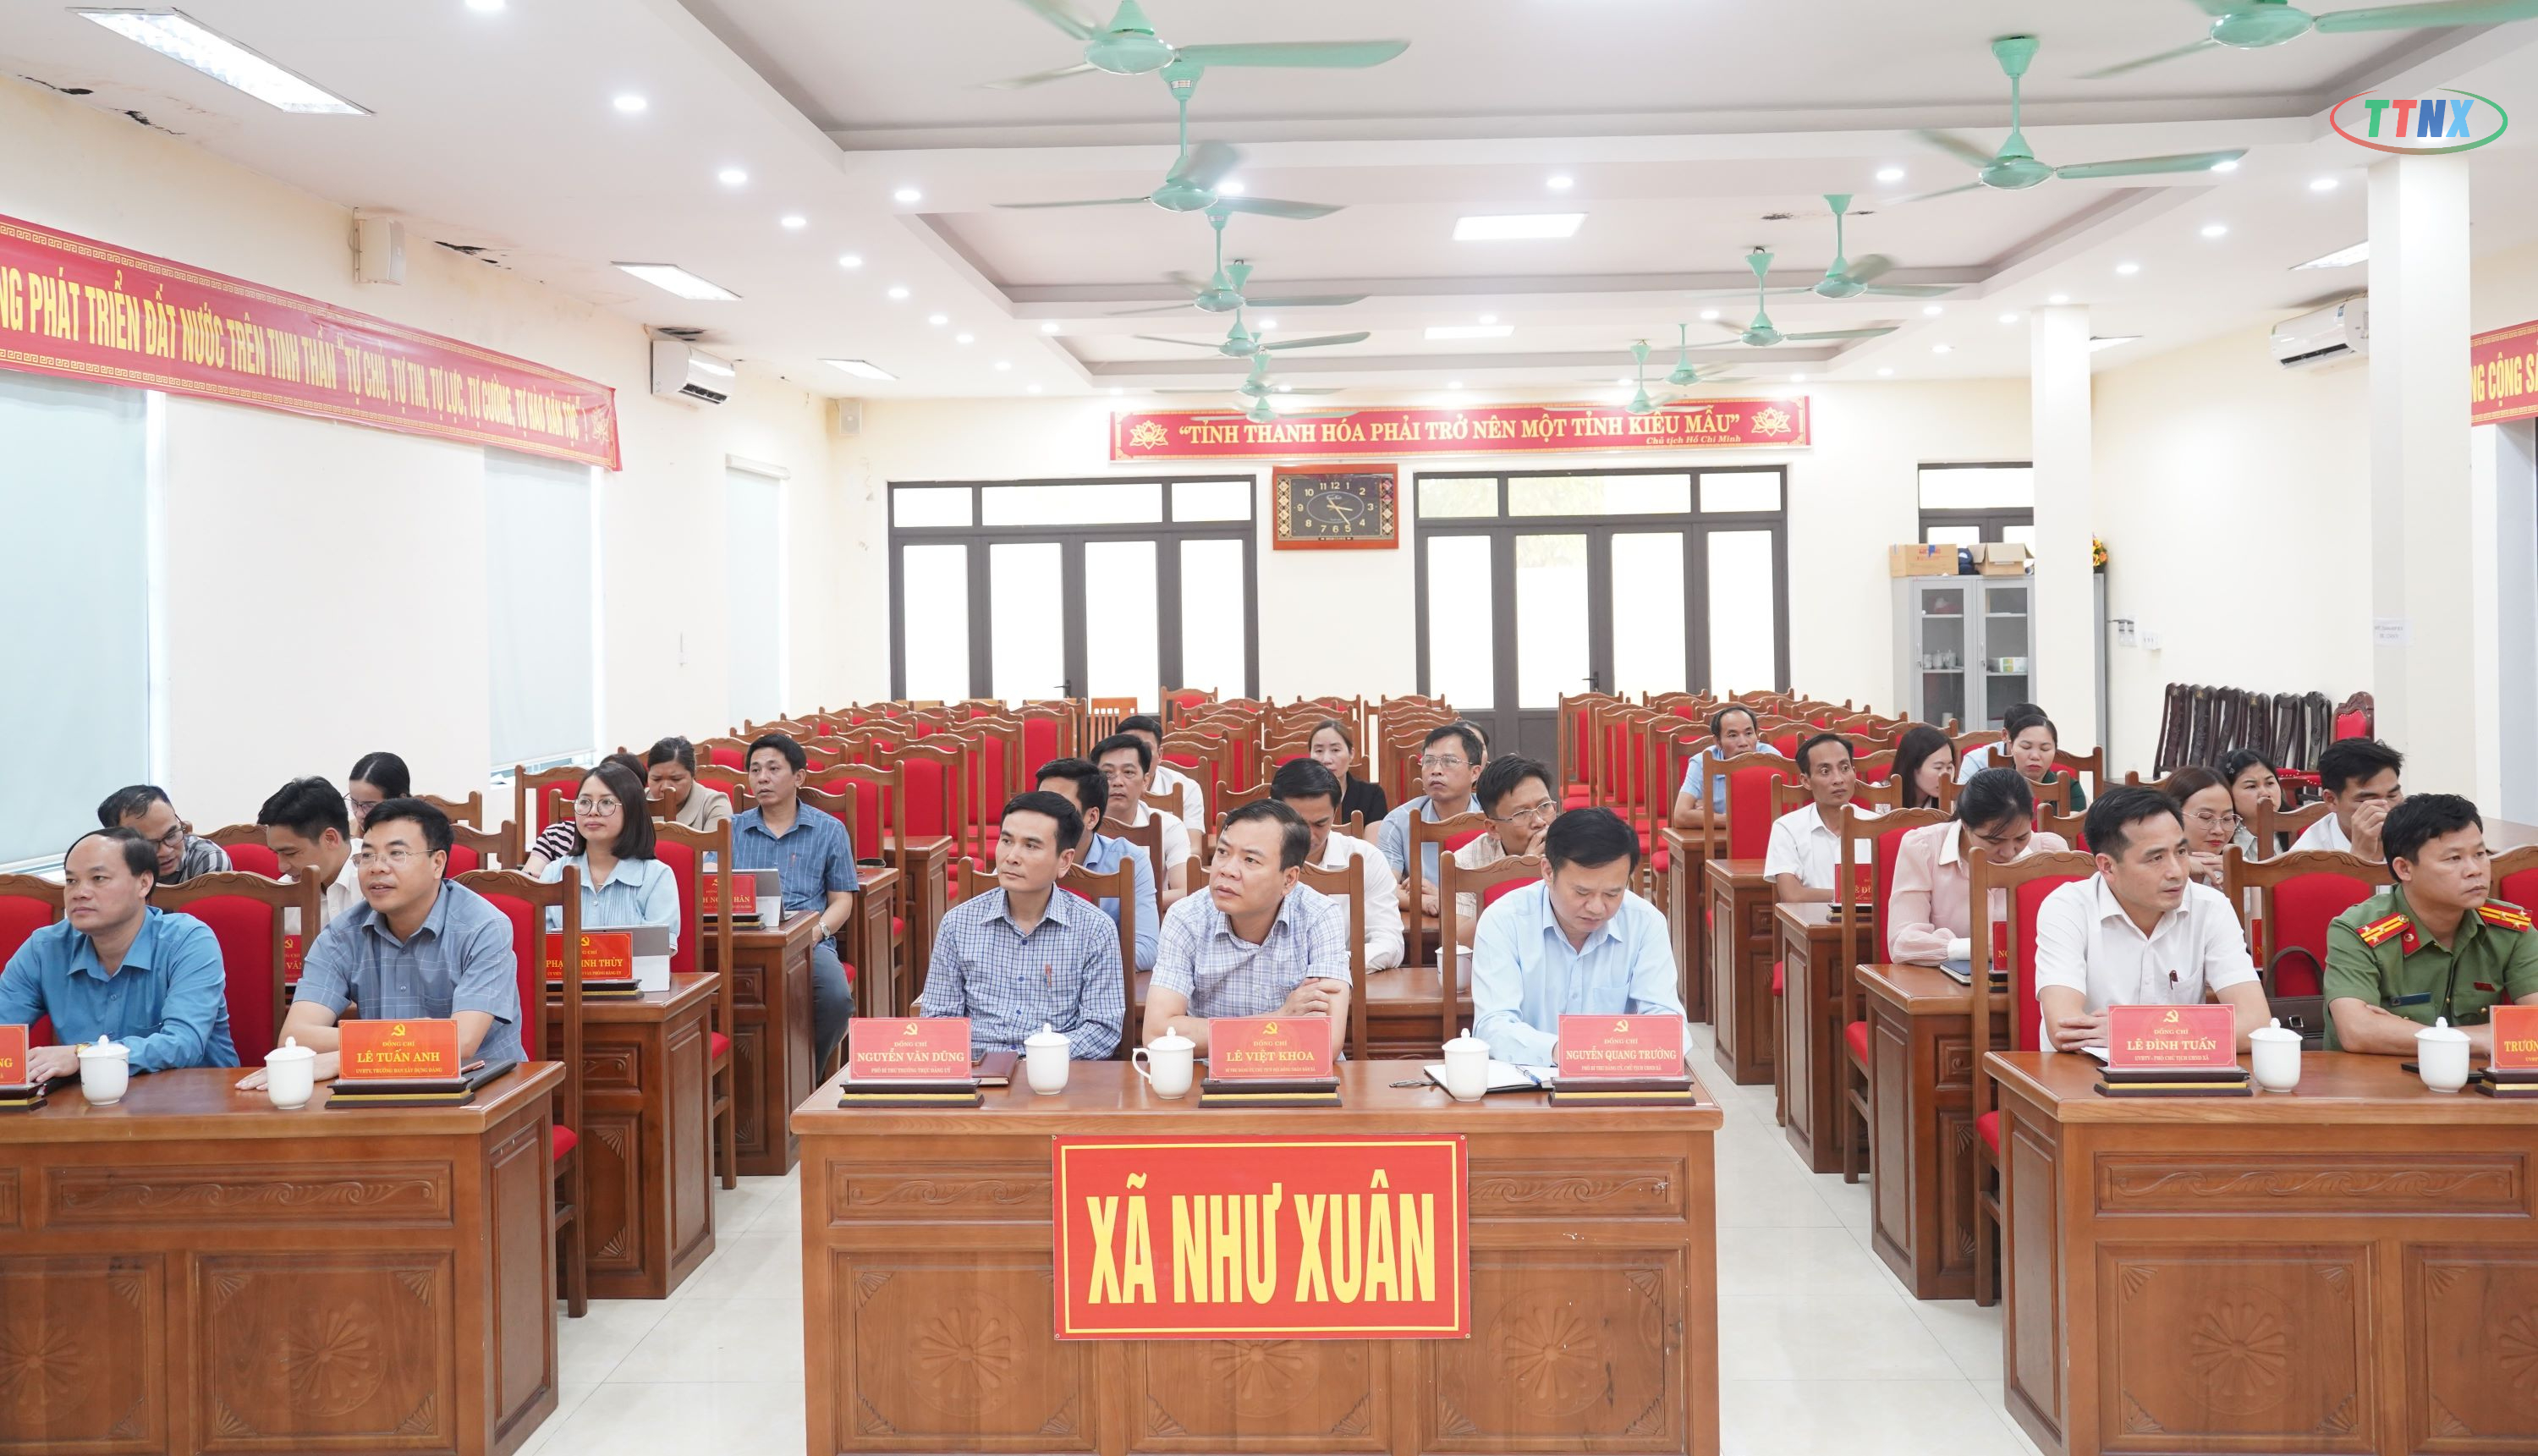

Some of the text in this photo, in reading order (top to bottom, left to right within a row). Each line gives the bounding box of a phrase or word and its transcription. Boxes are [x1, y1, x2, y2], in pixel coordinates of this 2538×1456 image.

[28, 266, 80, 342] PHÁT
[85, 270, 140, 352] TRIỂN
[144, 284, 176, 359] ĐẤT
[181, 302, 225, 368] NƯỚC
[227, 312, 266, 376] TRÊN
[266, 327, 300, 383] TINH
[301, 327, 337, 389] THẦN
[392, 356, 406, 414] TỰ
[430, 365, 444, 420] TỰ
[2488, 352, 2523, 407] CỘNG
[1179, 420, 1239, 443] “TỈNH
[1244, 424, 1316, 443] THANH
[1321, 418, 1366, 442] HÓA
[1370, 415, 1421, 441] PHẢI
[1425, 414, 1469, 440] TRỞ
[1472, 415, 1517, 439] NÊN
[1521, 413, 1568, 443] MỘT
[1571, 410, 1623, 437] TỈNH
[1667, 436, 1684, 446] tịch
[1718, 434, 1741, 442] Minh
[1320, 482, 1327, 491] 11
[1331, 481, 1340, 490] 12
[1305, 488, 1315, 497] 10
[1359, 487, 1366, 496] 2
[1296, 503, 1305, 513] 9
[1367, 503, 1375, 512] 3
[1305, 519, 1313, 528] 8
[1359, 519, 1366, 527] 4
[1320, 525, 1327, 533] 7
[1332, 525, 1340, 534] 6
[1344, 524, 1352, 533] 5
[546, 959, 563, 970] PHẠ
[2127, 1036, 2217, 1051] LÊ ĐÌNH TUẤN
[357, 1048, 440, 1063] LÊ TUẤN ANH
[857, 1048, 964, 1063] NGUYỄN VĂN DŨNG
[1226, 1049, 1315, 1063] LÊ VIỆT KHOA
[1566, 1046, 1677, 1061] NGUYỄN QUANG TRƯỜNG
[1086, 1169, 1436, 1304] XÃ NHƯ XUÂN
